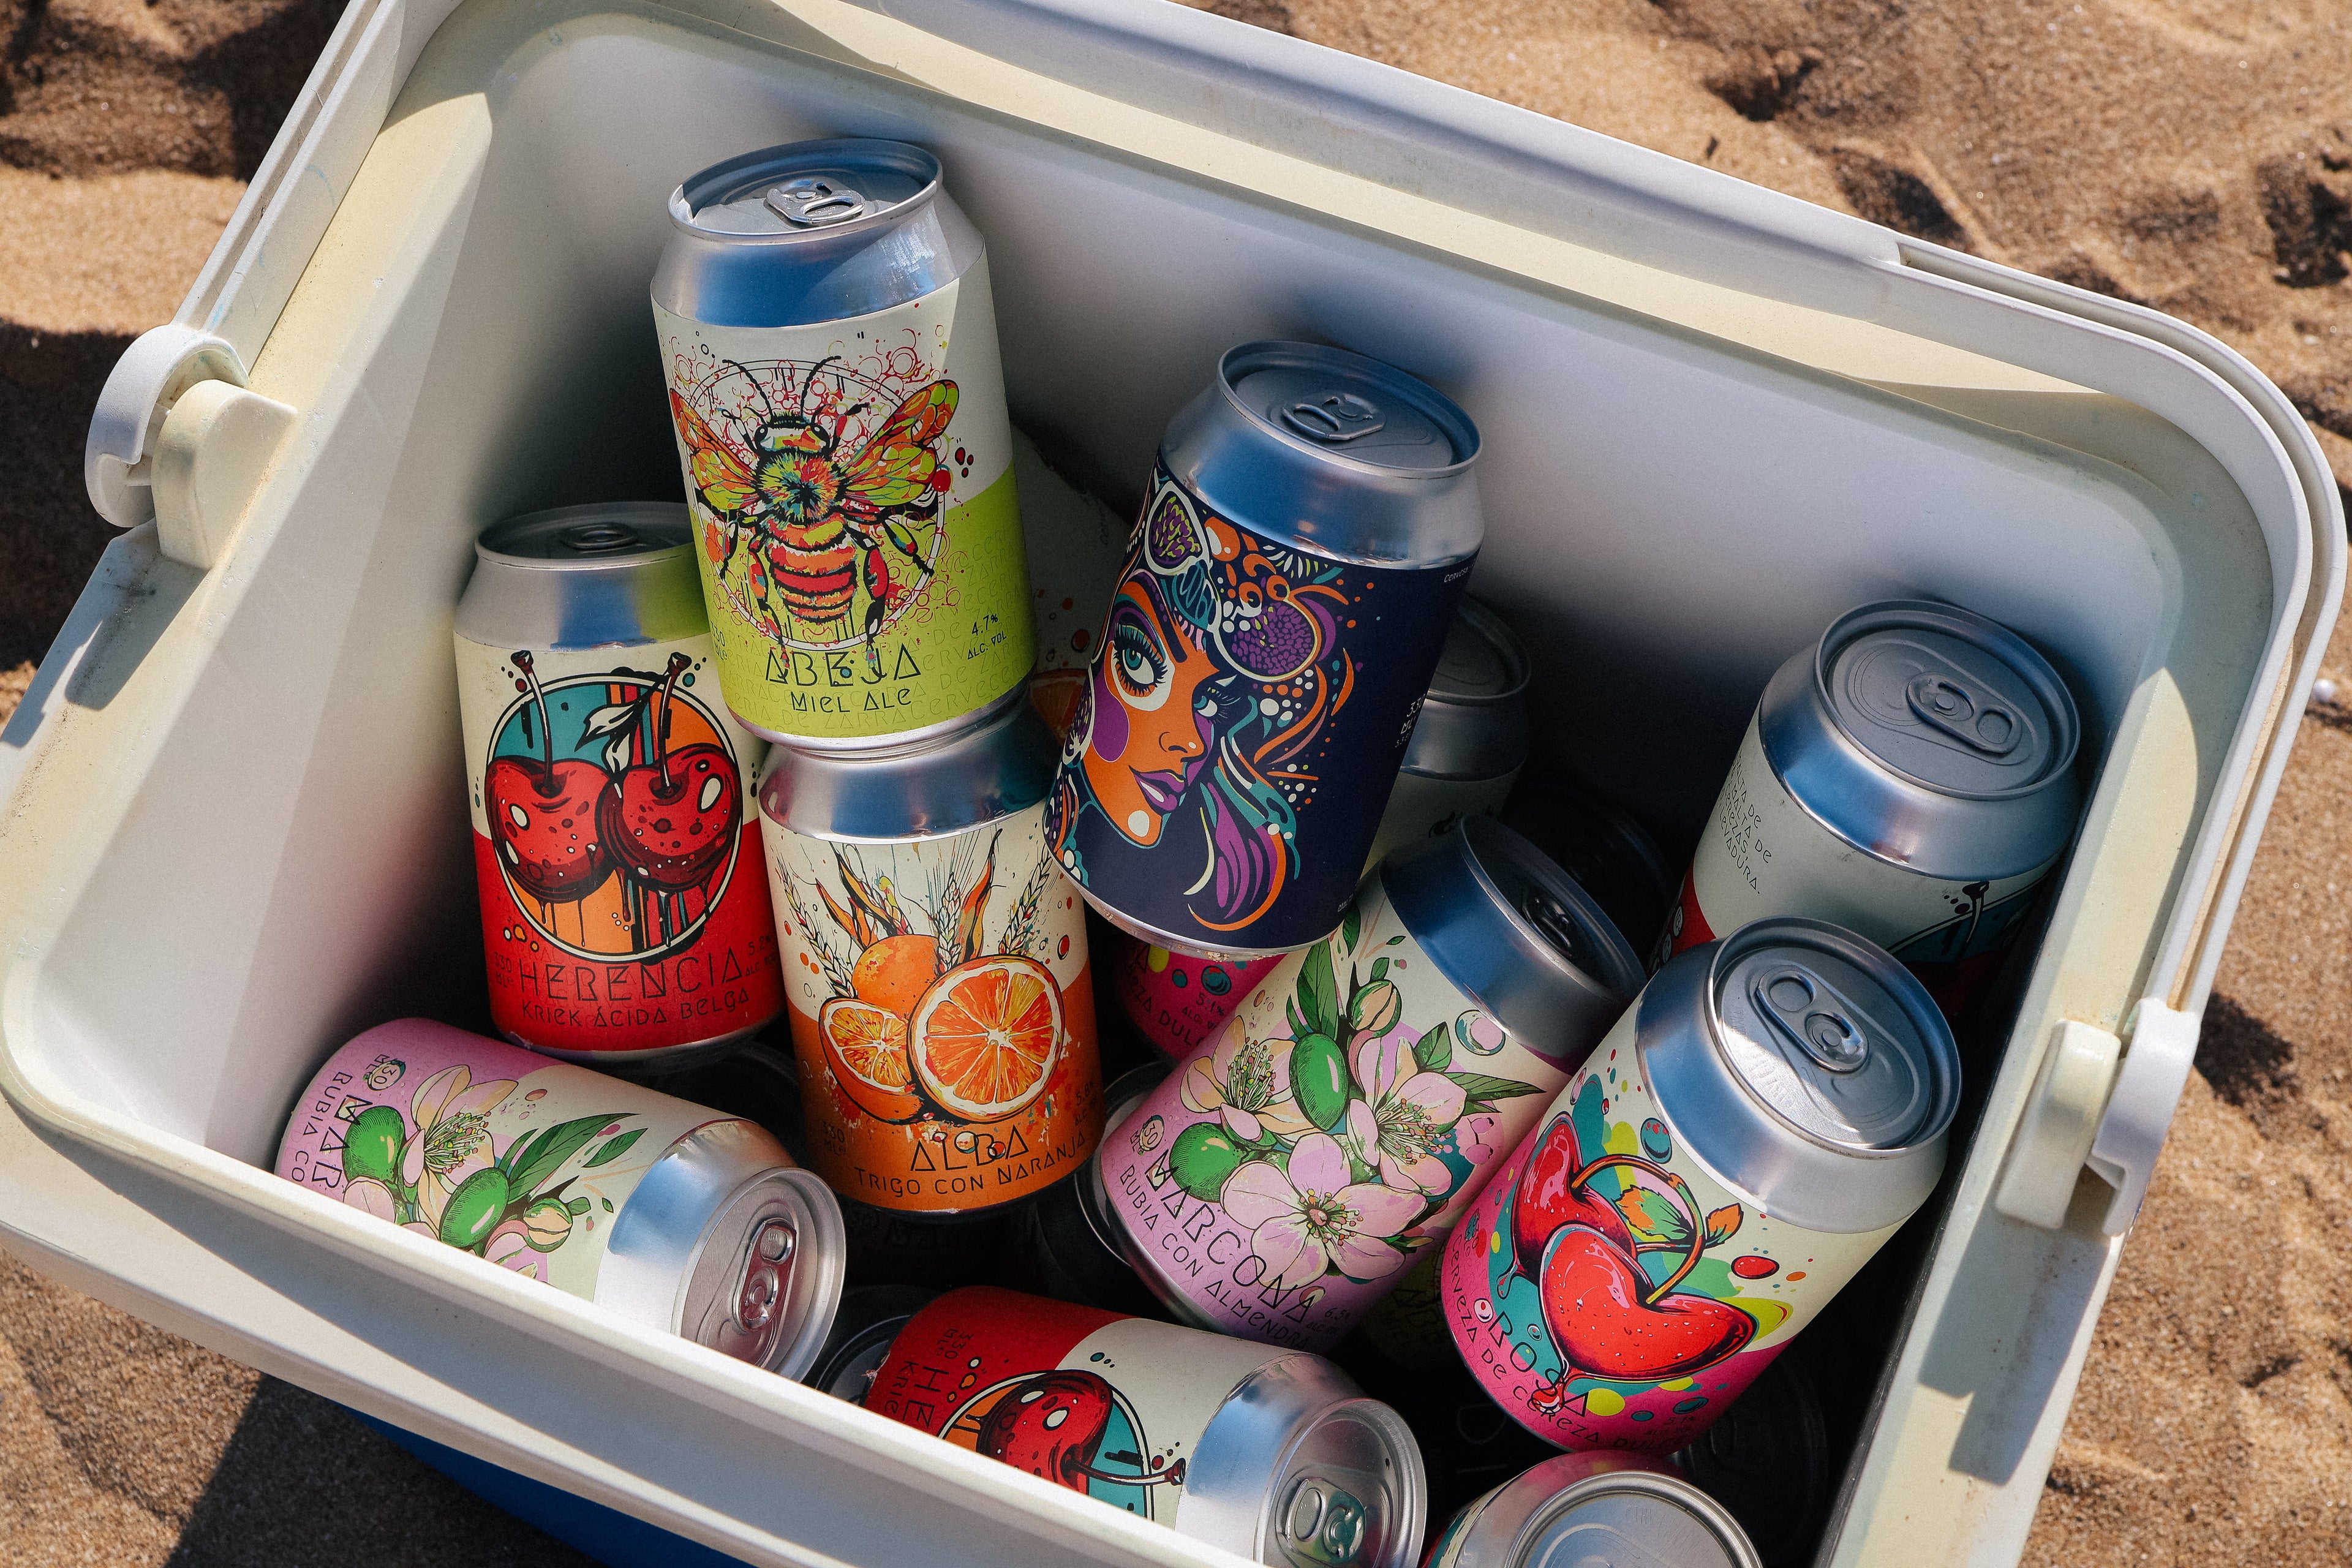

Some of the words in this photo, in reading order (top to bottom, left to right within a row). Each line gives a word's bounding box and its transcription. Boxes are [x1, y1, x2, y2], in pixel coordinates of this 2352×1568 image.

[967, 643, 989, 660] ALC.
[990, 630, 1007, 647] VOL
[971, 613, 998, 636] 4.7%
[766, 643, 921, 687] ABEJA
[519, 947, 743, 1001] HERENCIA
[522, 999, 582, 1027] KRIEK
[594, 1003, 668, 1027] ÁCIDA
[680, 987, 749, 1020] BELGA
[303, 1071, 353, 1136] RUBIA
[291, 1150, 309, 1182] CO
[854, 1167, 921, 1198] TRIGO
[935, 1174, 984, 1195] CON
[998, 1131, 1085, 1185] NARANJA
[910, 1125, 1030, 1172] ALBA
[1120, 1164, 1162, 1231] RUBIA
[1161, 1232, 1204, 1278] CON
[1144, 1148, 1316, 1324] MARCONA
[1450, 1234, 1479, 1344] CERVEZA
[1481, 1348, 1507, 1381] DE
[944, 1331, 974, 1359] 330
[884, 1360, 919, 1414] KRIE
